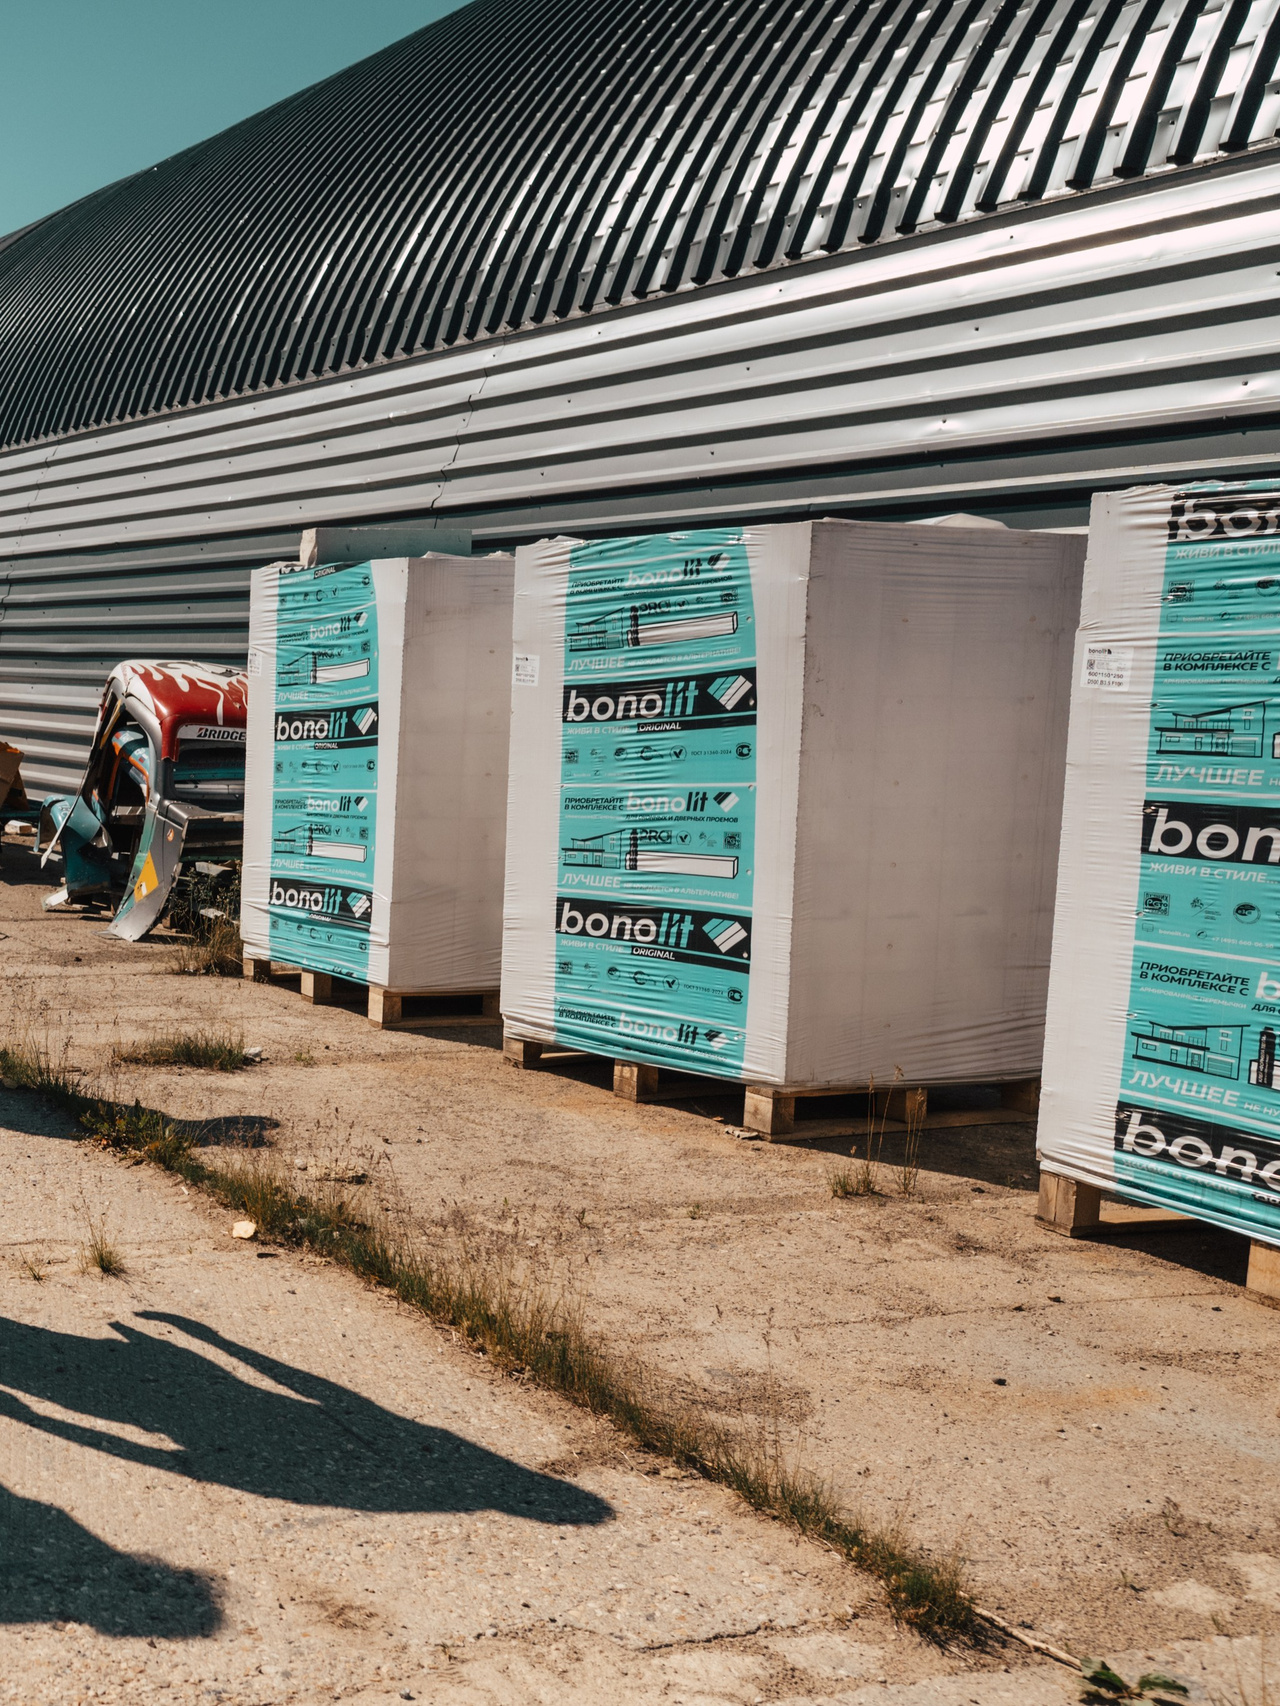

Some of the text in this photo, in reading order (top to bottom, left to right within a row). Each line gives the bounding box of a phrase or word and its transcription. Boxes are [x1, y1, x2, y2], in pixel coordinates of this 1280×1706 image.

[1174, 547, 1220, 560] ЖИВИ
[1223, 546, 1233, 557] В
[625, 557, 702, 588] bonolit
[310, 615, 352, 639] bonolit
[569, 656, 625, 671] ЛУЧШЕЕ
[1163, 650, 1271, 662] ПРИОБРЕТАЙТЕ
[1163, 661, 1271, 671] В КОМПЛЕКСЕ С
[566, 681, 698, 722] bonolit
[276, 711, 348, 741] bonolit
[567, 727, 593, 735] ЖИВИ
[594, 726, 600, 734] В
[639, 721, 682, 732] ORIGINAL
[196, 727, 247, 742] BRIDGE
[1153, 764, 1266, 787] ЛУЧШЕЕ
[307, 795, 352, 812] bonolit
[564, 796, 624, 804] ПРИОБРЕТАЙТЕ
[626, 791, 708, 813] bonolit
[674, 815, 705, 823] ДВЕРНЫХ
[1149, 862, 1198, 877] ЖИВИ
[1200, 866, 1211, 877] В
[562, 873, 622, 889] ЛУЧШЕЕ
[270, 881, 343, 915] bonolit
[680, 888, 739, 900] АЛЬТЕРНАТИВЕ!
[560, 902, 694, 948] bonolit
[1158, 928, 1190, 938] bonolit.ru
[560, 938, 587, 948] ЖИВИ
[587, 941, 594, 949] В
[632, 946, 676, 960] ORIGINAL
[1140, 961, 1250, 987] ПРИОБРЕТАЙТЕ
[1139, 971, 1250, 996] В КОМПЛЕКСЕ С
[564, 1013, 610, 1028] КОМПЛЕКСЕ
[619, 1012, 700, 1046] bonolit
[1128, 1069, 1240, 1108] ЛУЧШЕЕ
[1243, 1101, 1261, 1113] НЕ
